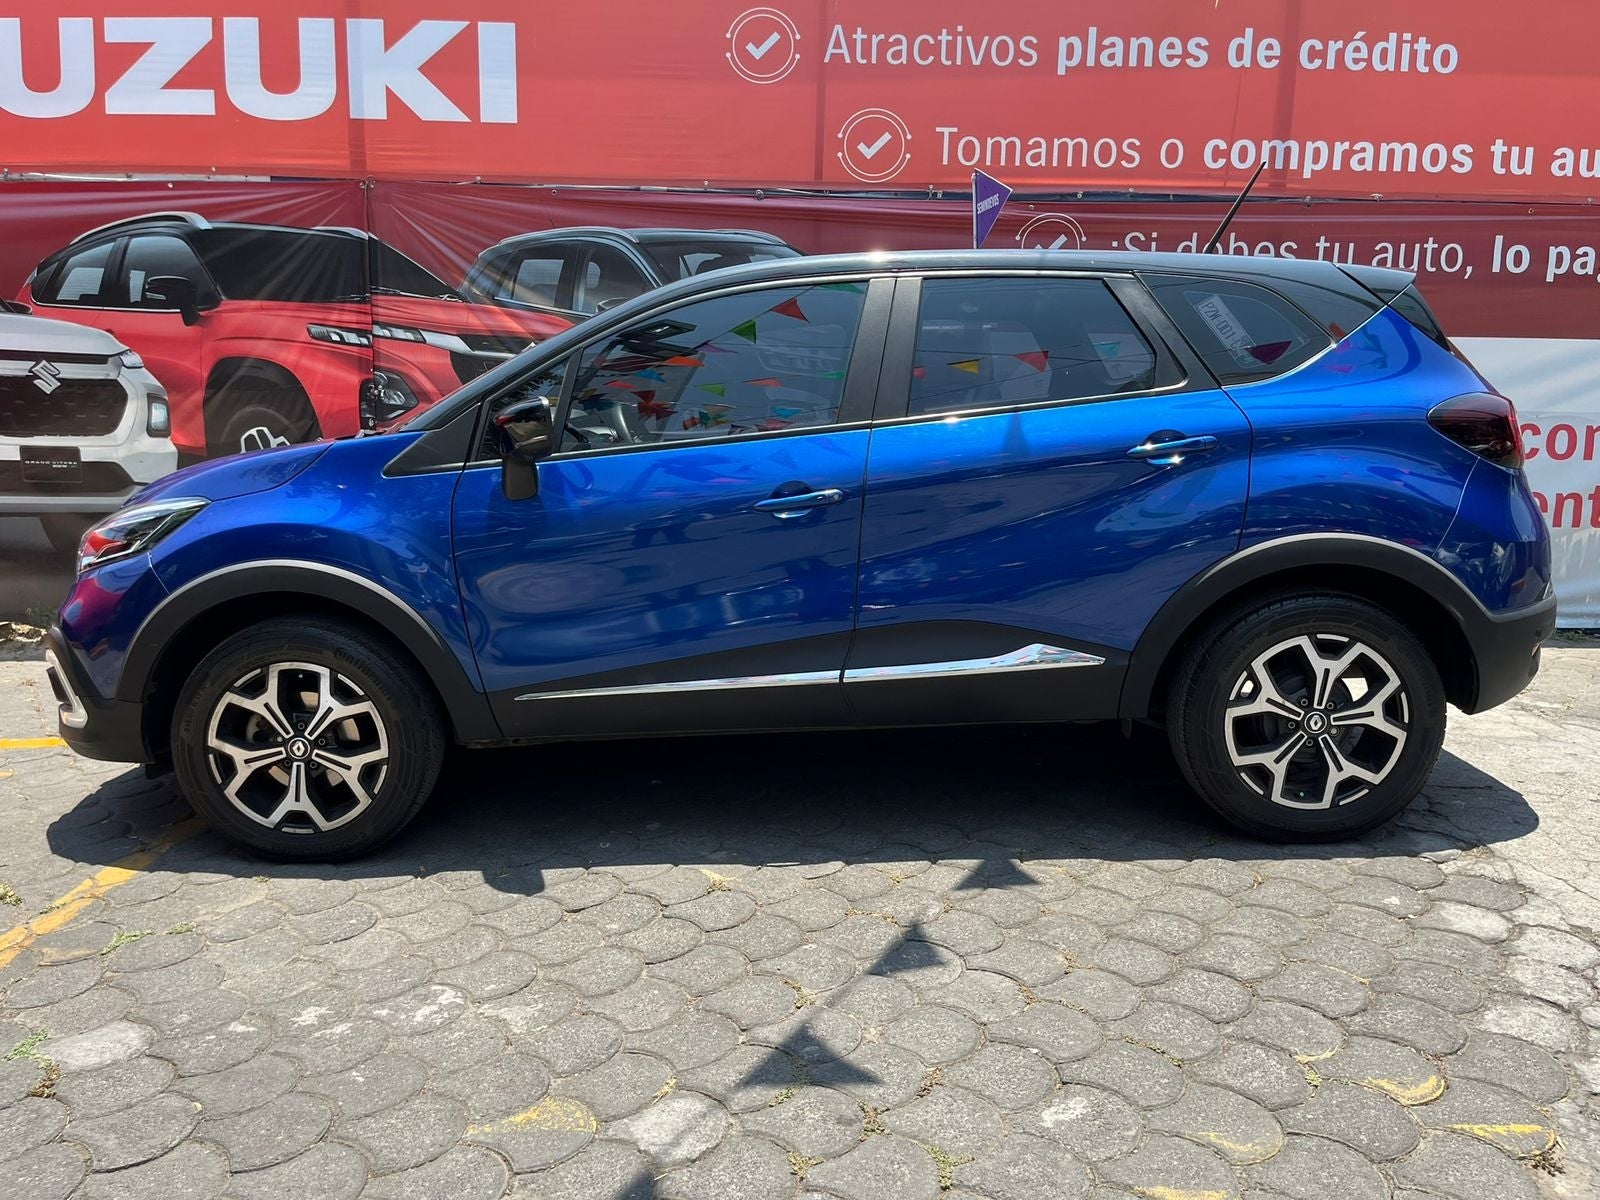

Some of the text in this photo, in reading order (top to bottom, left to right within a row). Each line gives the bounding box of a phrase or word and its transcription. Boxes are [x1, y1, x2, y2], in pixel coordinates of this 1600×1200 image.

[823, 24, 1459, 75] Atractivos planes de crédito
[935, 126, 1141, 169] Tomamos
[1160, 137, 1184, 169] o
[1203, 138, 1474, 179] compramos
[1490, 139, 1534, 175] tu
[1315, 236, 1355, 264] tu
[1371, 236, 1473, 280] auto,
[1492, 235, 1531, 275] lo
[1545, 245, 1600, 283] pa
